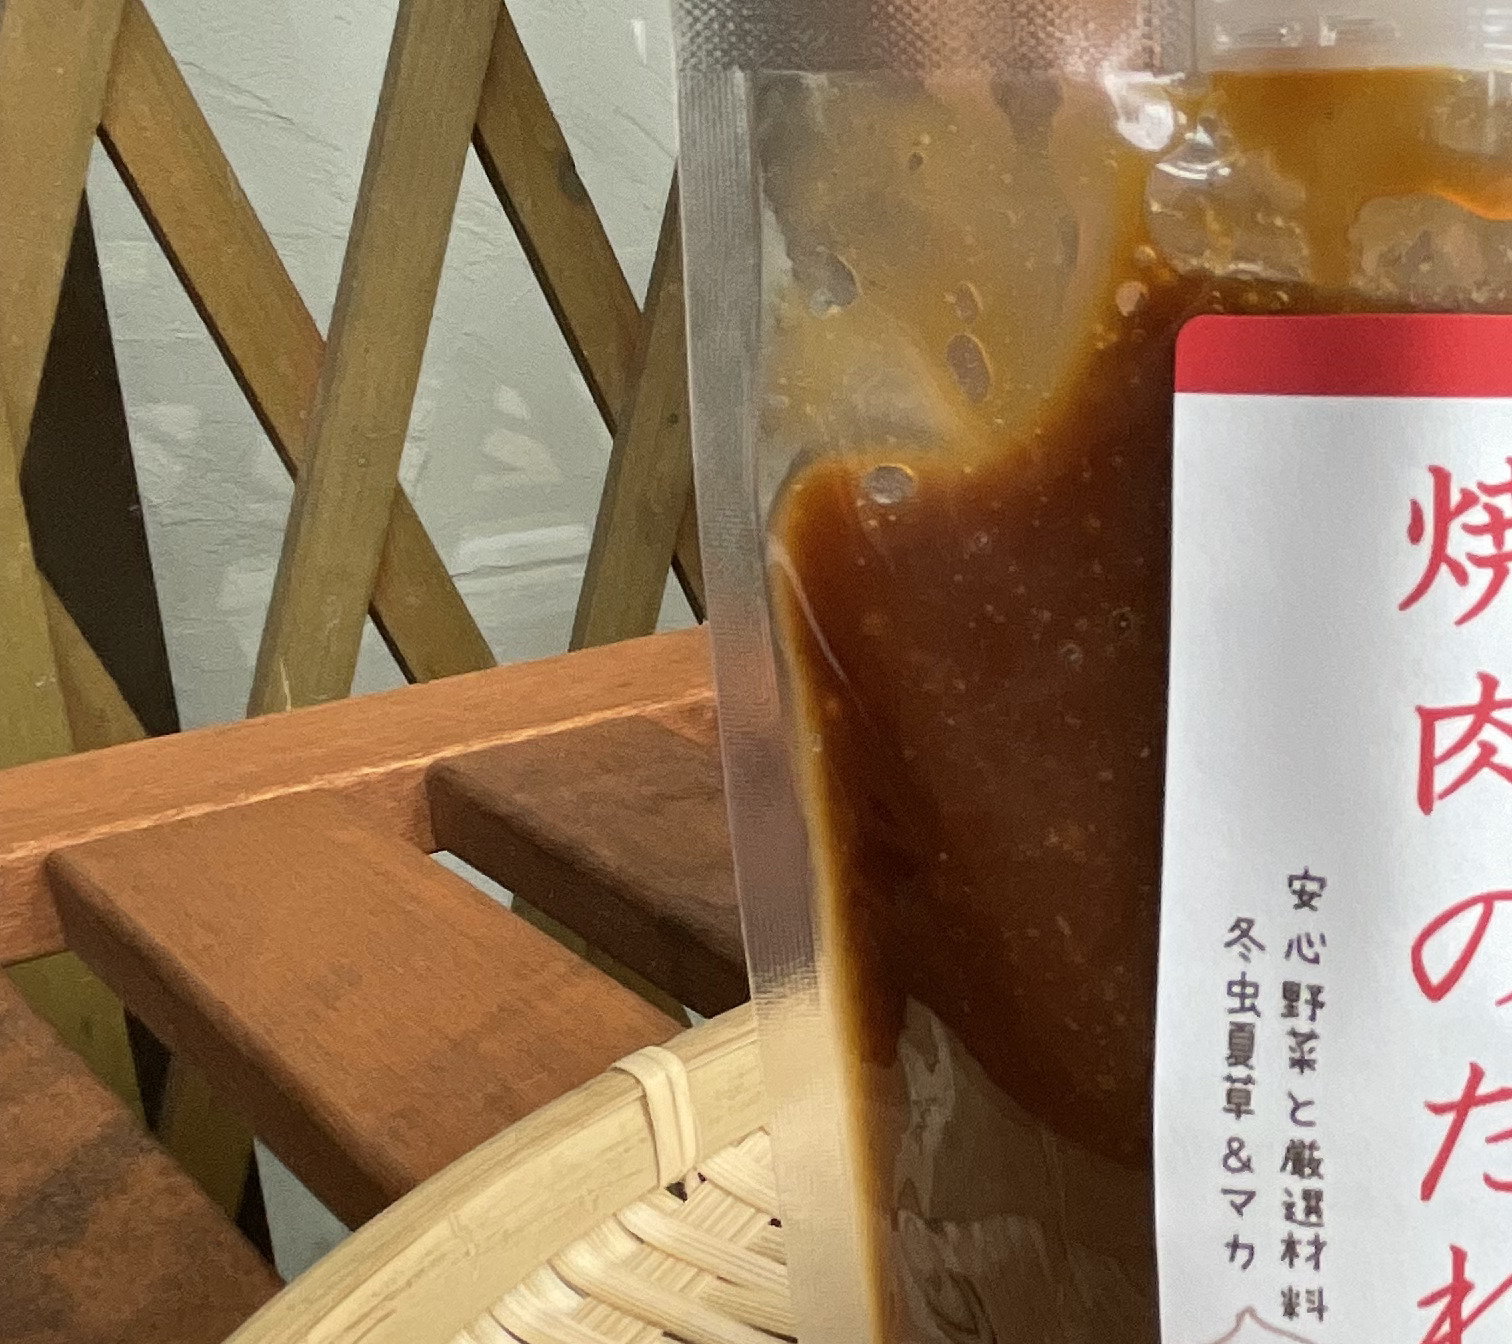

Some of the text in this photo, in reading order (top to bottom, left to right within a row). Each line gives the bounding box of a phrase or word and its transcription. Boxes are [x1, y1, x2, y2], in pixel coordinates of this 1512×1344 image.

[1279, 866, 1329, 1323] 安心野菜と厳選材料
